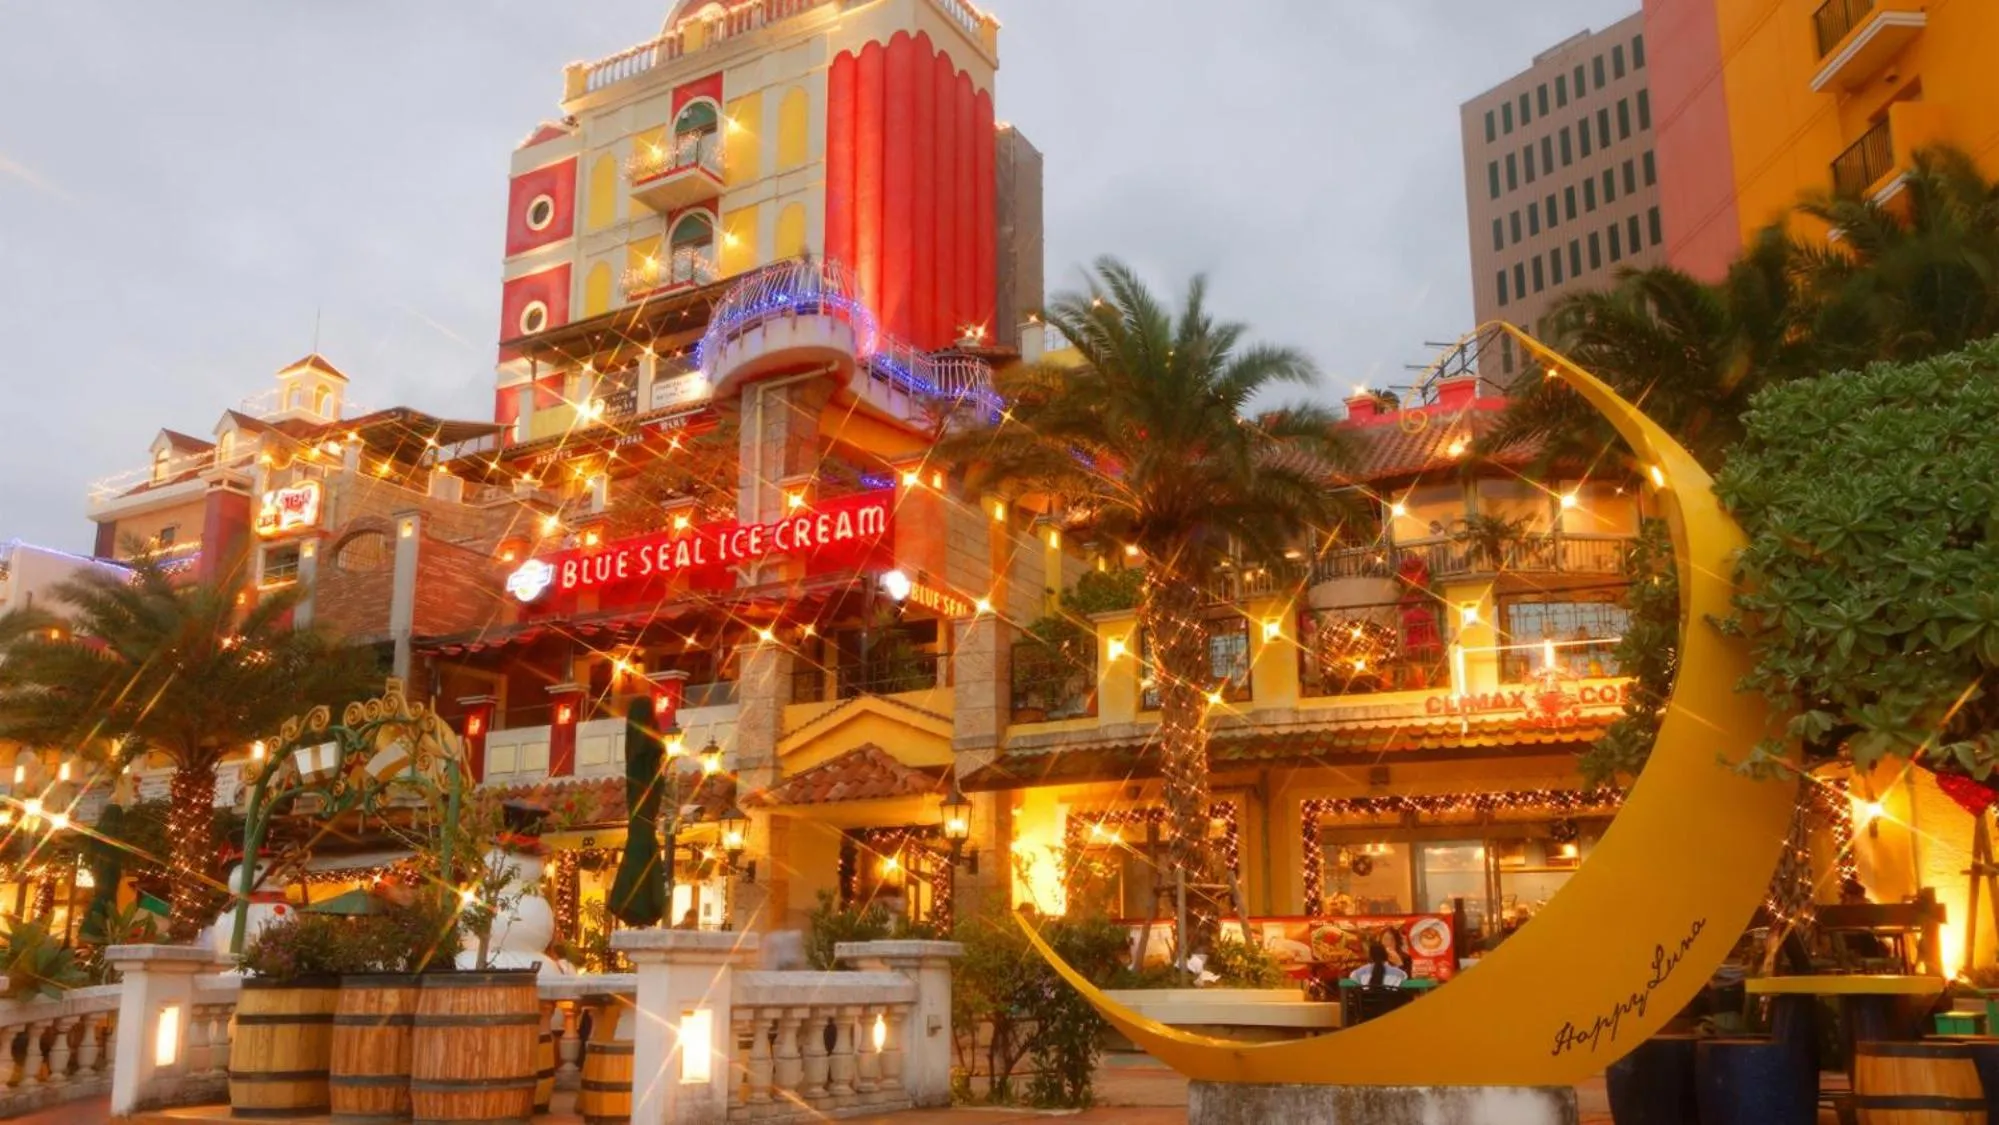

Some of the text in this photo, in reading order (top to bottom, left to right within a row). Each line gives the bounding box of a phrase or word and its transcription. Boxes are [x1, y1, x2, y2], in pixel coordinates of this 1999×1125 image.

[562, 551, 629, 588] BLUE
[639, 537, 706, 575] SEAL
[719, 526, 763, 560] ICE
[774, 505, 886, 550] CREAM
[911, 581, 940, 610] BLUE
[1425, 690, 1526, 714] CLIMAX
[1552, 917, 1707, 1056] Happy Luna
